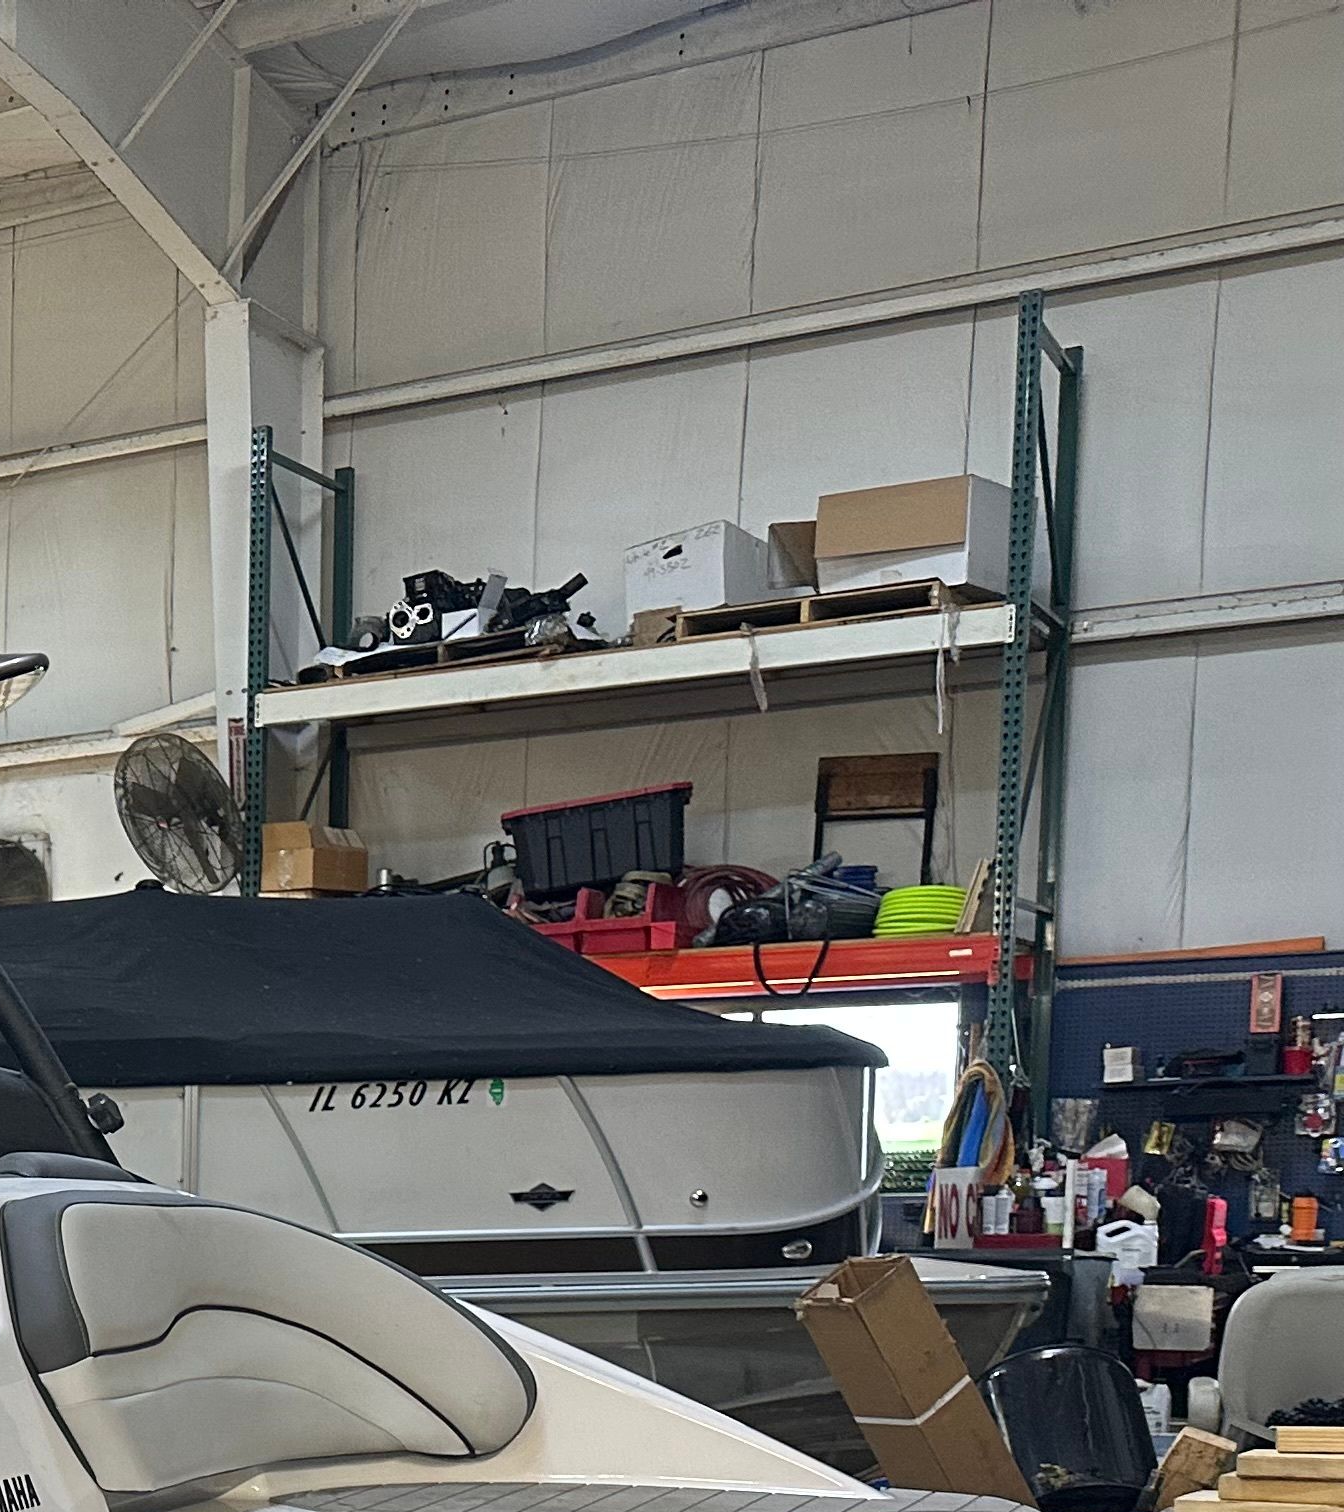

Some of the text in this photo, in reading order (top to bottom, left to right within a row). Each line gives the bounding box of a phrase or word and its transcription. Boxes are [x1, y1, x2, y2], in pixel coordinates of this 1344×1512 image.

[309, 1077, 477, 1113] IL 6250 KZ
[937, 1183, 960, 1240] NO
